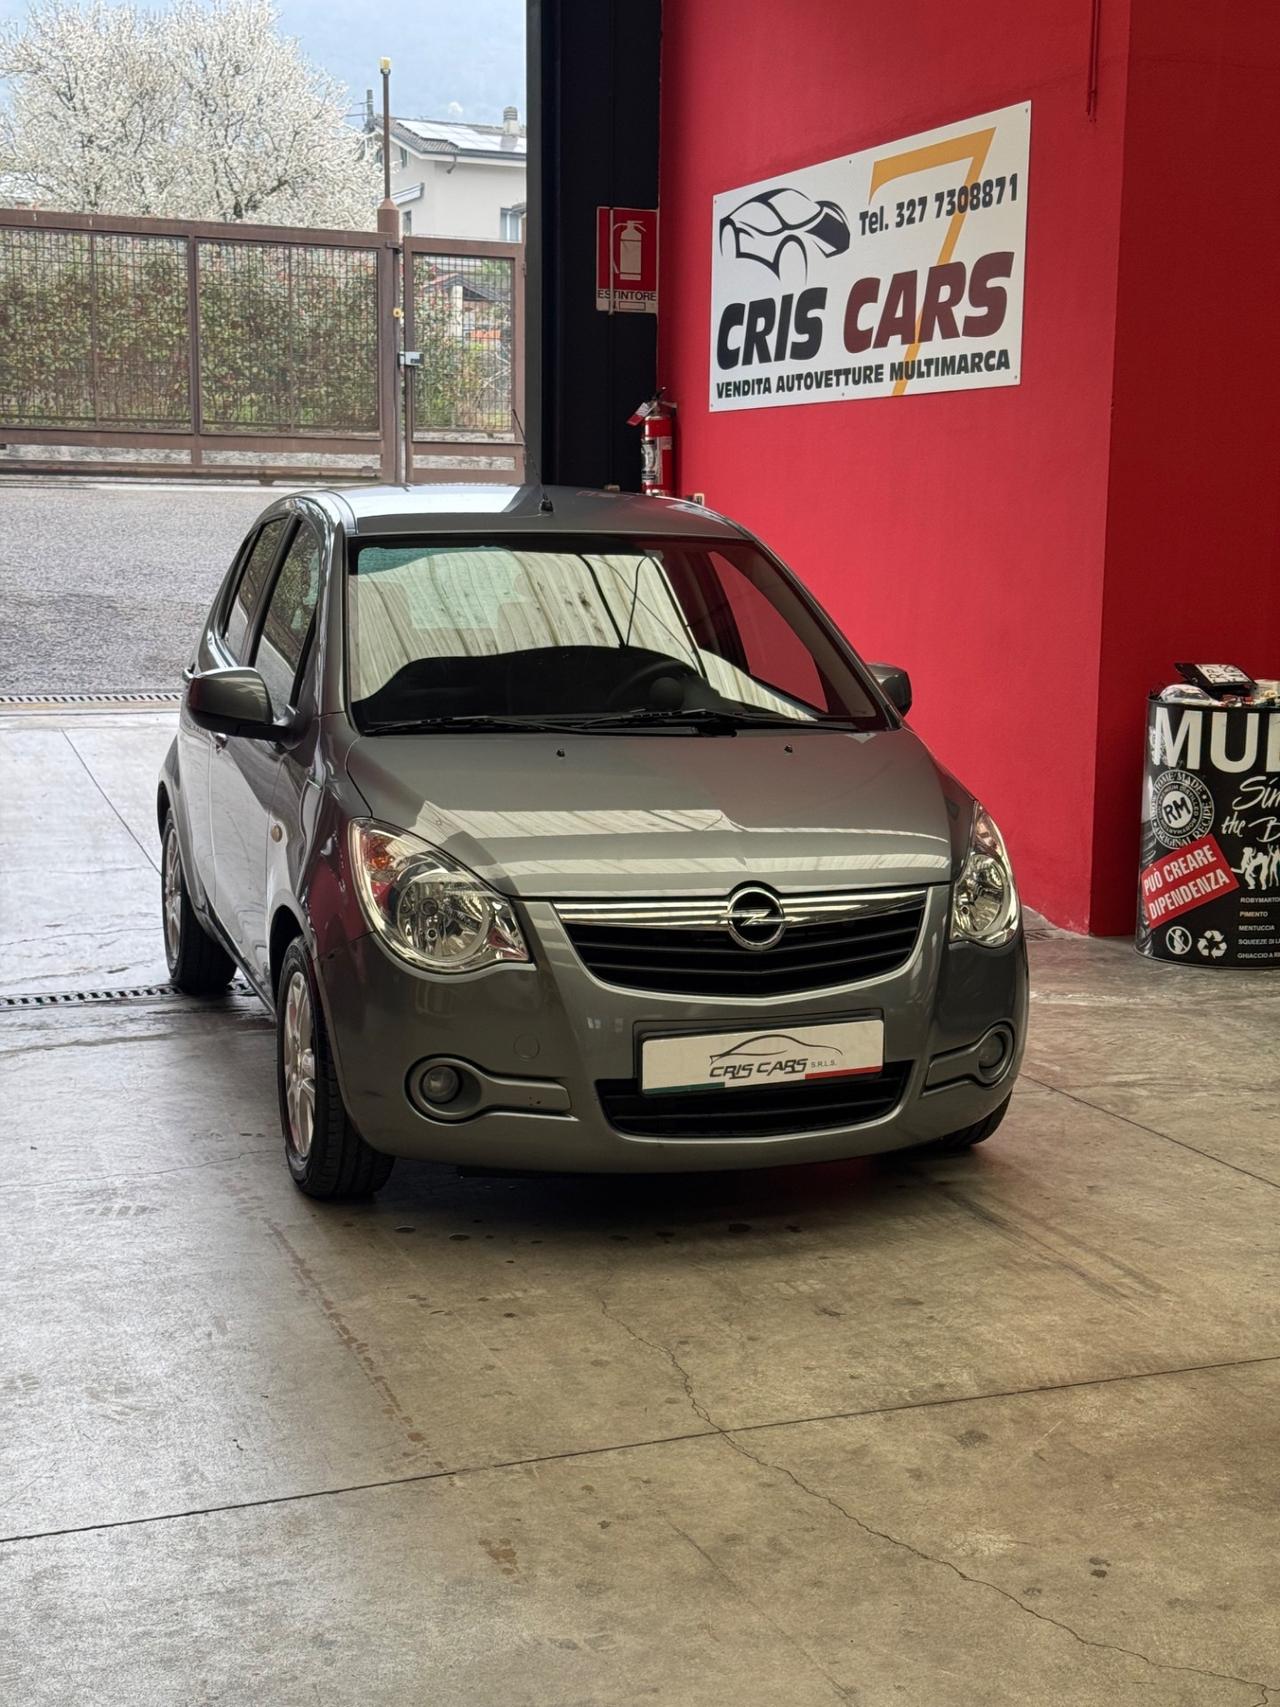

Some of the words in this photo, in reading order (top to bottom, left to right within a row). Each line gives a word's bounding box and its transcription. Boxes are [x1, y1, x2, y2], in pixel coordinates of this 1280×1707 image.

[858, 209, 889, 236] Tel.
[895, 196, 928, 229] 327
[934, 173, 1019, 219] 7308871
[716, 287, 828, 371] CRIS
[843, 251, 1015, 354] CARS
[716, 378, 772, 399] VENDITA
[775, 363, 884, 394] AUTOVETTURE
[889, 348, 1011, 382] MULTIMARCA
[1150, 706, 1280, 773] MU
[1163, 796, 1192, 824] RM
[1163, 845, 1217, 883] CREARE
[1148, 868, 1231, 920] DIPENDENZA
[709, 1063, 754, 1080] CRIS
[756, 1058, 809, 1076] CARS
